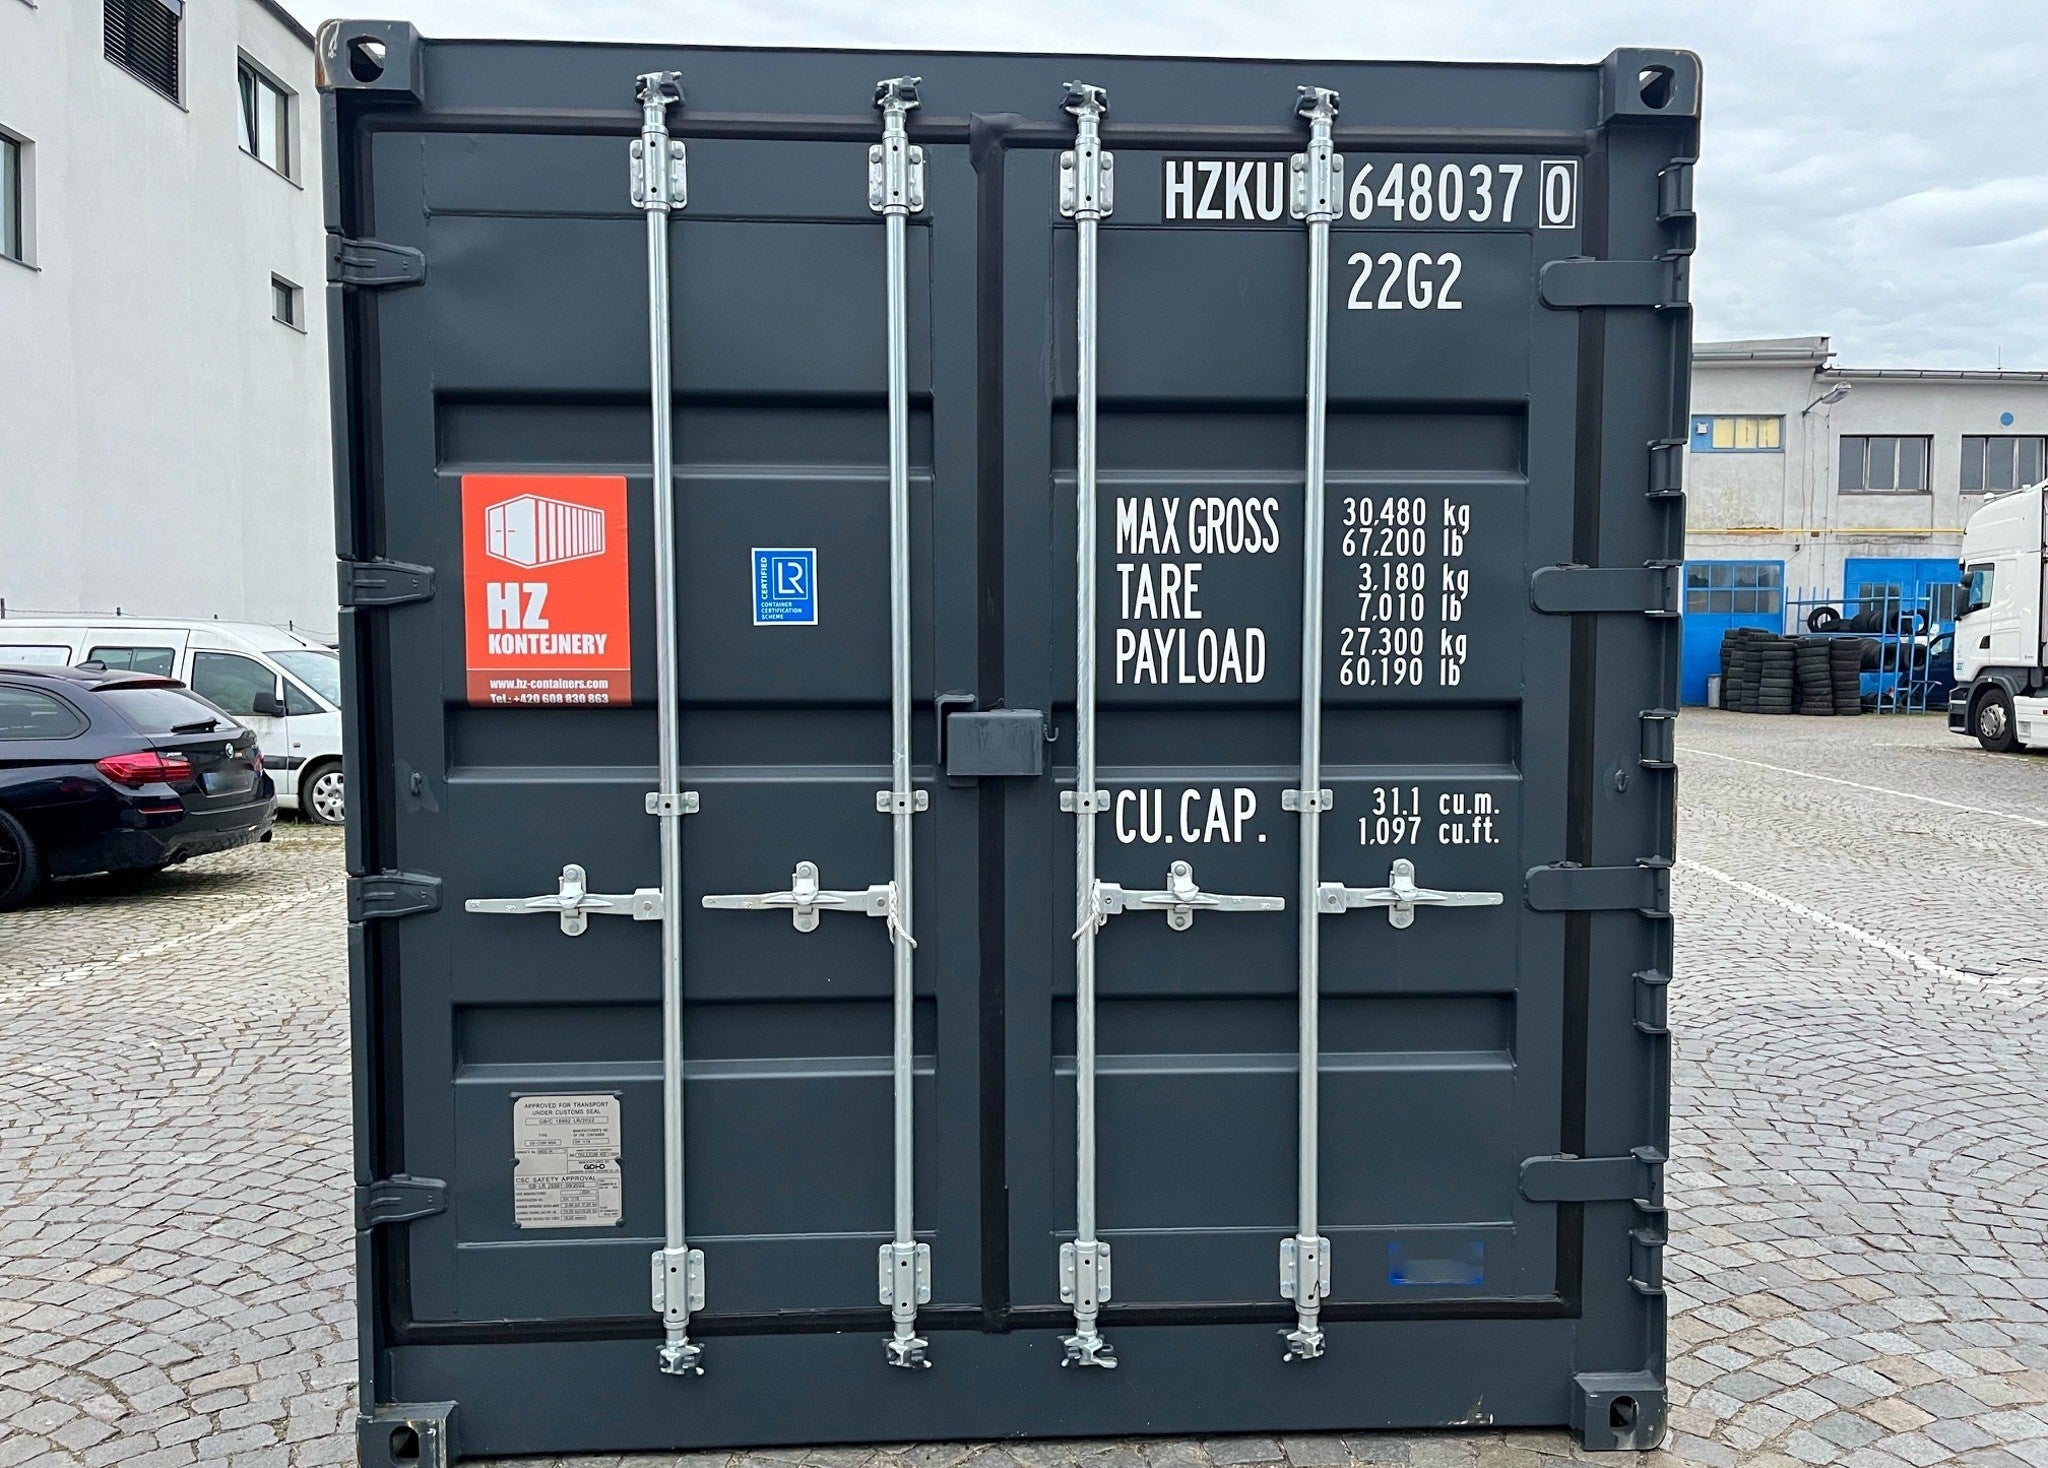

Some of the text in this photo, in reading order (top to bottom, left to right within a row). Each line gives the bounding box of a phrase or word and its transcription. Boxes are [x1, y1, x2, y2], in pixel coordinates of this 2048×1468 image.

[1166, 161, 1570, 223] HZKU 648037 0
[1348, 253, 1462, 309] 22G2
[1117, 497, 1470, 554] MAX GROSS 30,480 kg
[1342, 528, 1464, 556] 67,200 lb
[778, 562, 804, 594] LR
[1117, 562, 1469, 619] TARE 3,180 kg
[487, 583, 549, 629] HZ
[1358, 593, 1462, 622] 7,010 lb
[489, 634, 607, 654] KONTEJNERY
[1117, 627, 1466, 684] PAYLOAD 27,300 kg
[490, 679, 608, 688] www.hz-containers.com
[1340, 658, 1460, 686] 60,190 lb
[514, 694, 540, 703] +420
[1116, 787, 1500, 843] CU.CAP. 31.1 cu.m.
[1359, 816, 1499, 845] 1,097 cu.ft.
